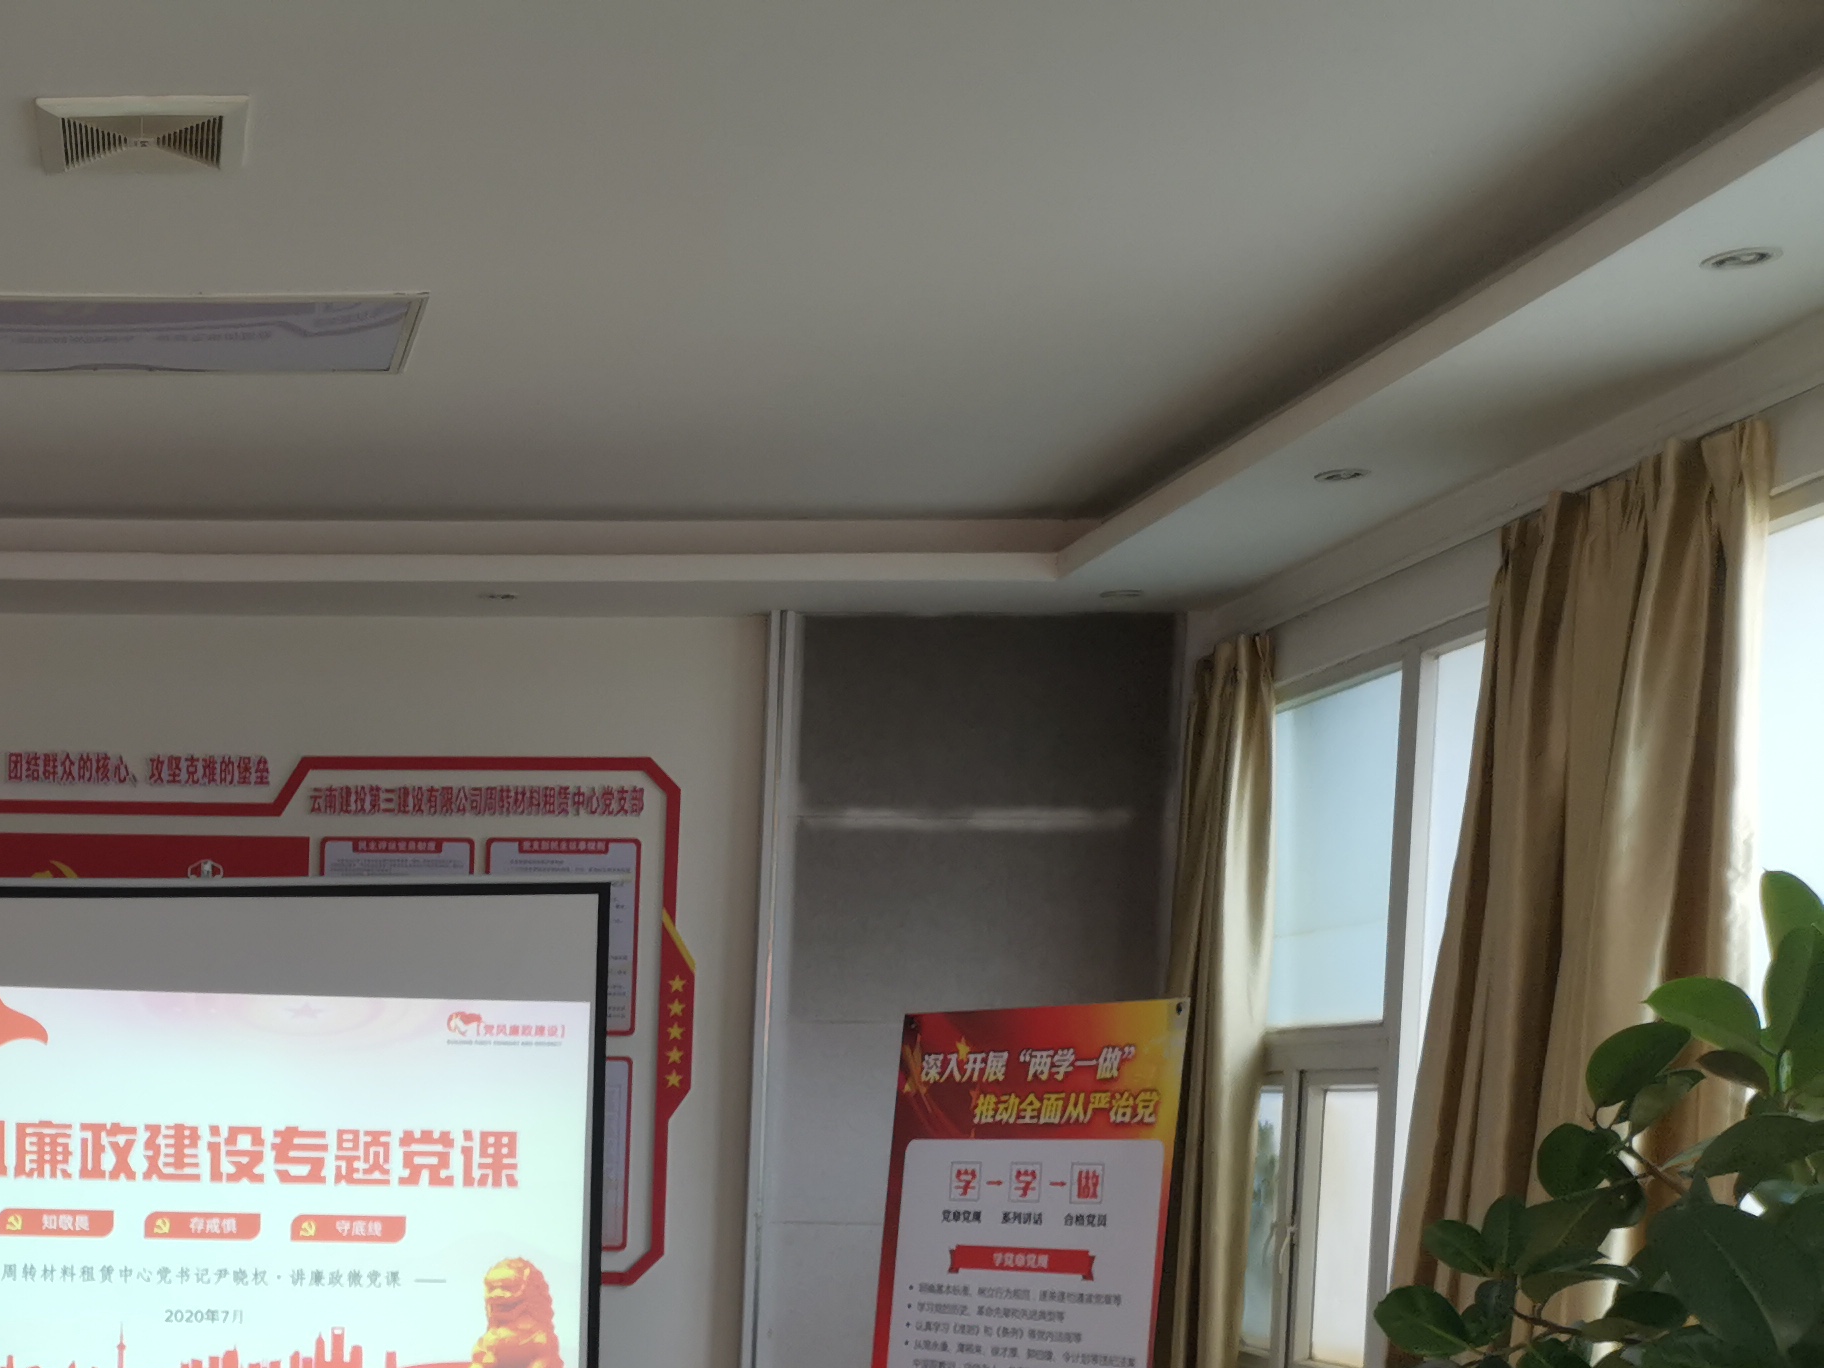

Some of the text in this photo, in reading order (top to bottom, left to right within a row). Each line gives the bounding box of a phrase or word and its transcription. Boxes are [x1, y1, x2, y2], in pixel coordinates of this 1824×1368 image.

[973, 1090, 1161, 1125] 推动全面从严治党
[954, 1168, 1099, 1199] 学 学 做
[41, 1214, 91, 1232] 知敬畏
[188, 1217, 238, 1235] 存戒惧
[335, 1220, 383, 1238] 守底线
[164, 1307, 245, 1326] 2020年7月
